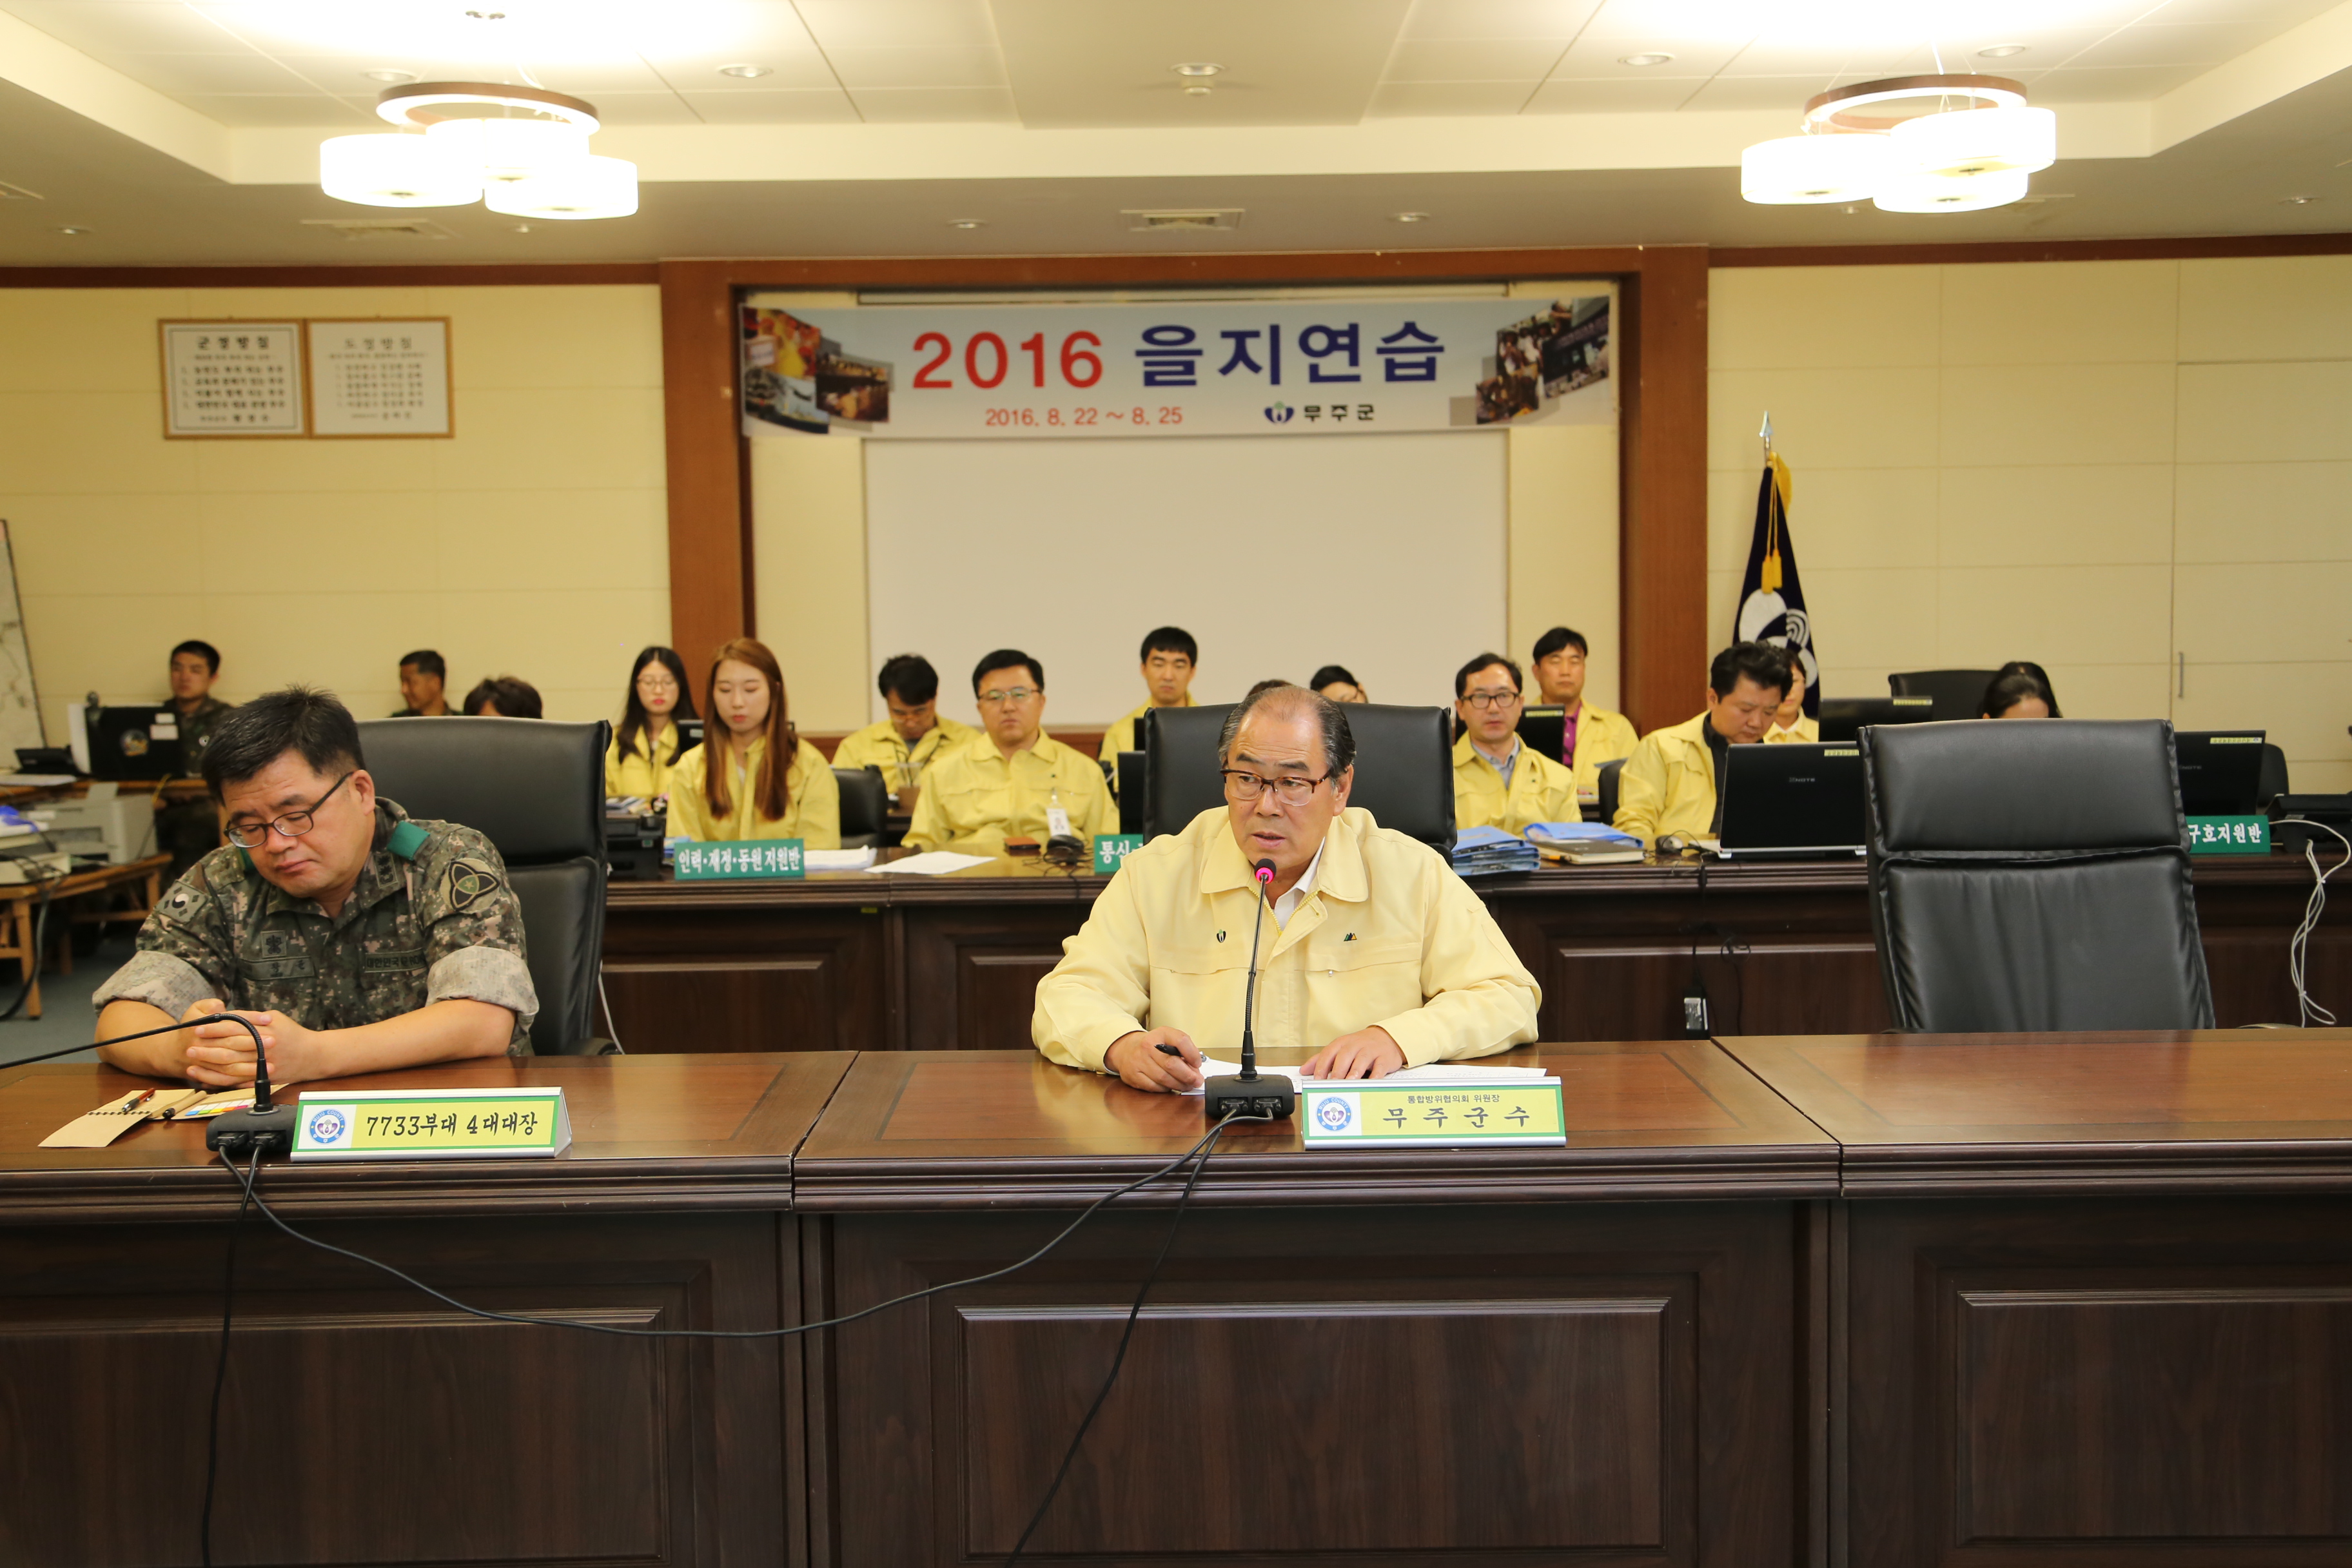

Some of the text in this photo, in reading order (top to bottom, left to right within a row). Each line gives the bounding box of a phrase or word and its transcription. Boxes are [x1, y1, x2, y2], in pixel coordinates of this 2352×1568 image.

[912, 321, 1446, 389] 2016 을지연습
[985, 407, 1039, 427] 2016.
[1047, 407, 1066, 427] 8.
[1073, 407, 1098, 426] 22
[1132, 406, 1150, 426] 8.
[1159, 406, 1183, 425] 25
[1304, 404, 1375, 422] 무주군
[2188, 822, 2262, 845] 구호지원반
[765, 846, 801, 872] 지원반
[1099, 840, 1143, 864] 통신
[1331, 1098, 1349, 1109] COUNTY
[1407, 1094, 1500, 1103] 통합방위협의회 위원장
[327, 1110, 344, 1121] COUNTY
[367, 1111, 538, 1137] 7733부대 4 대대장
